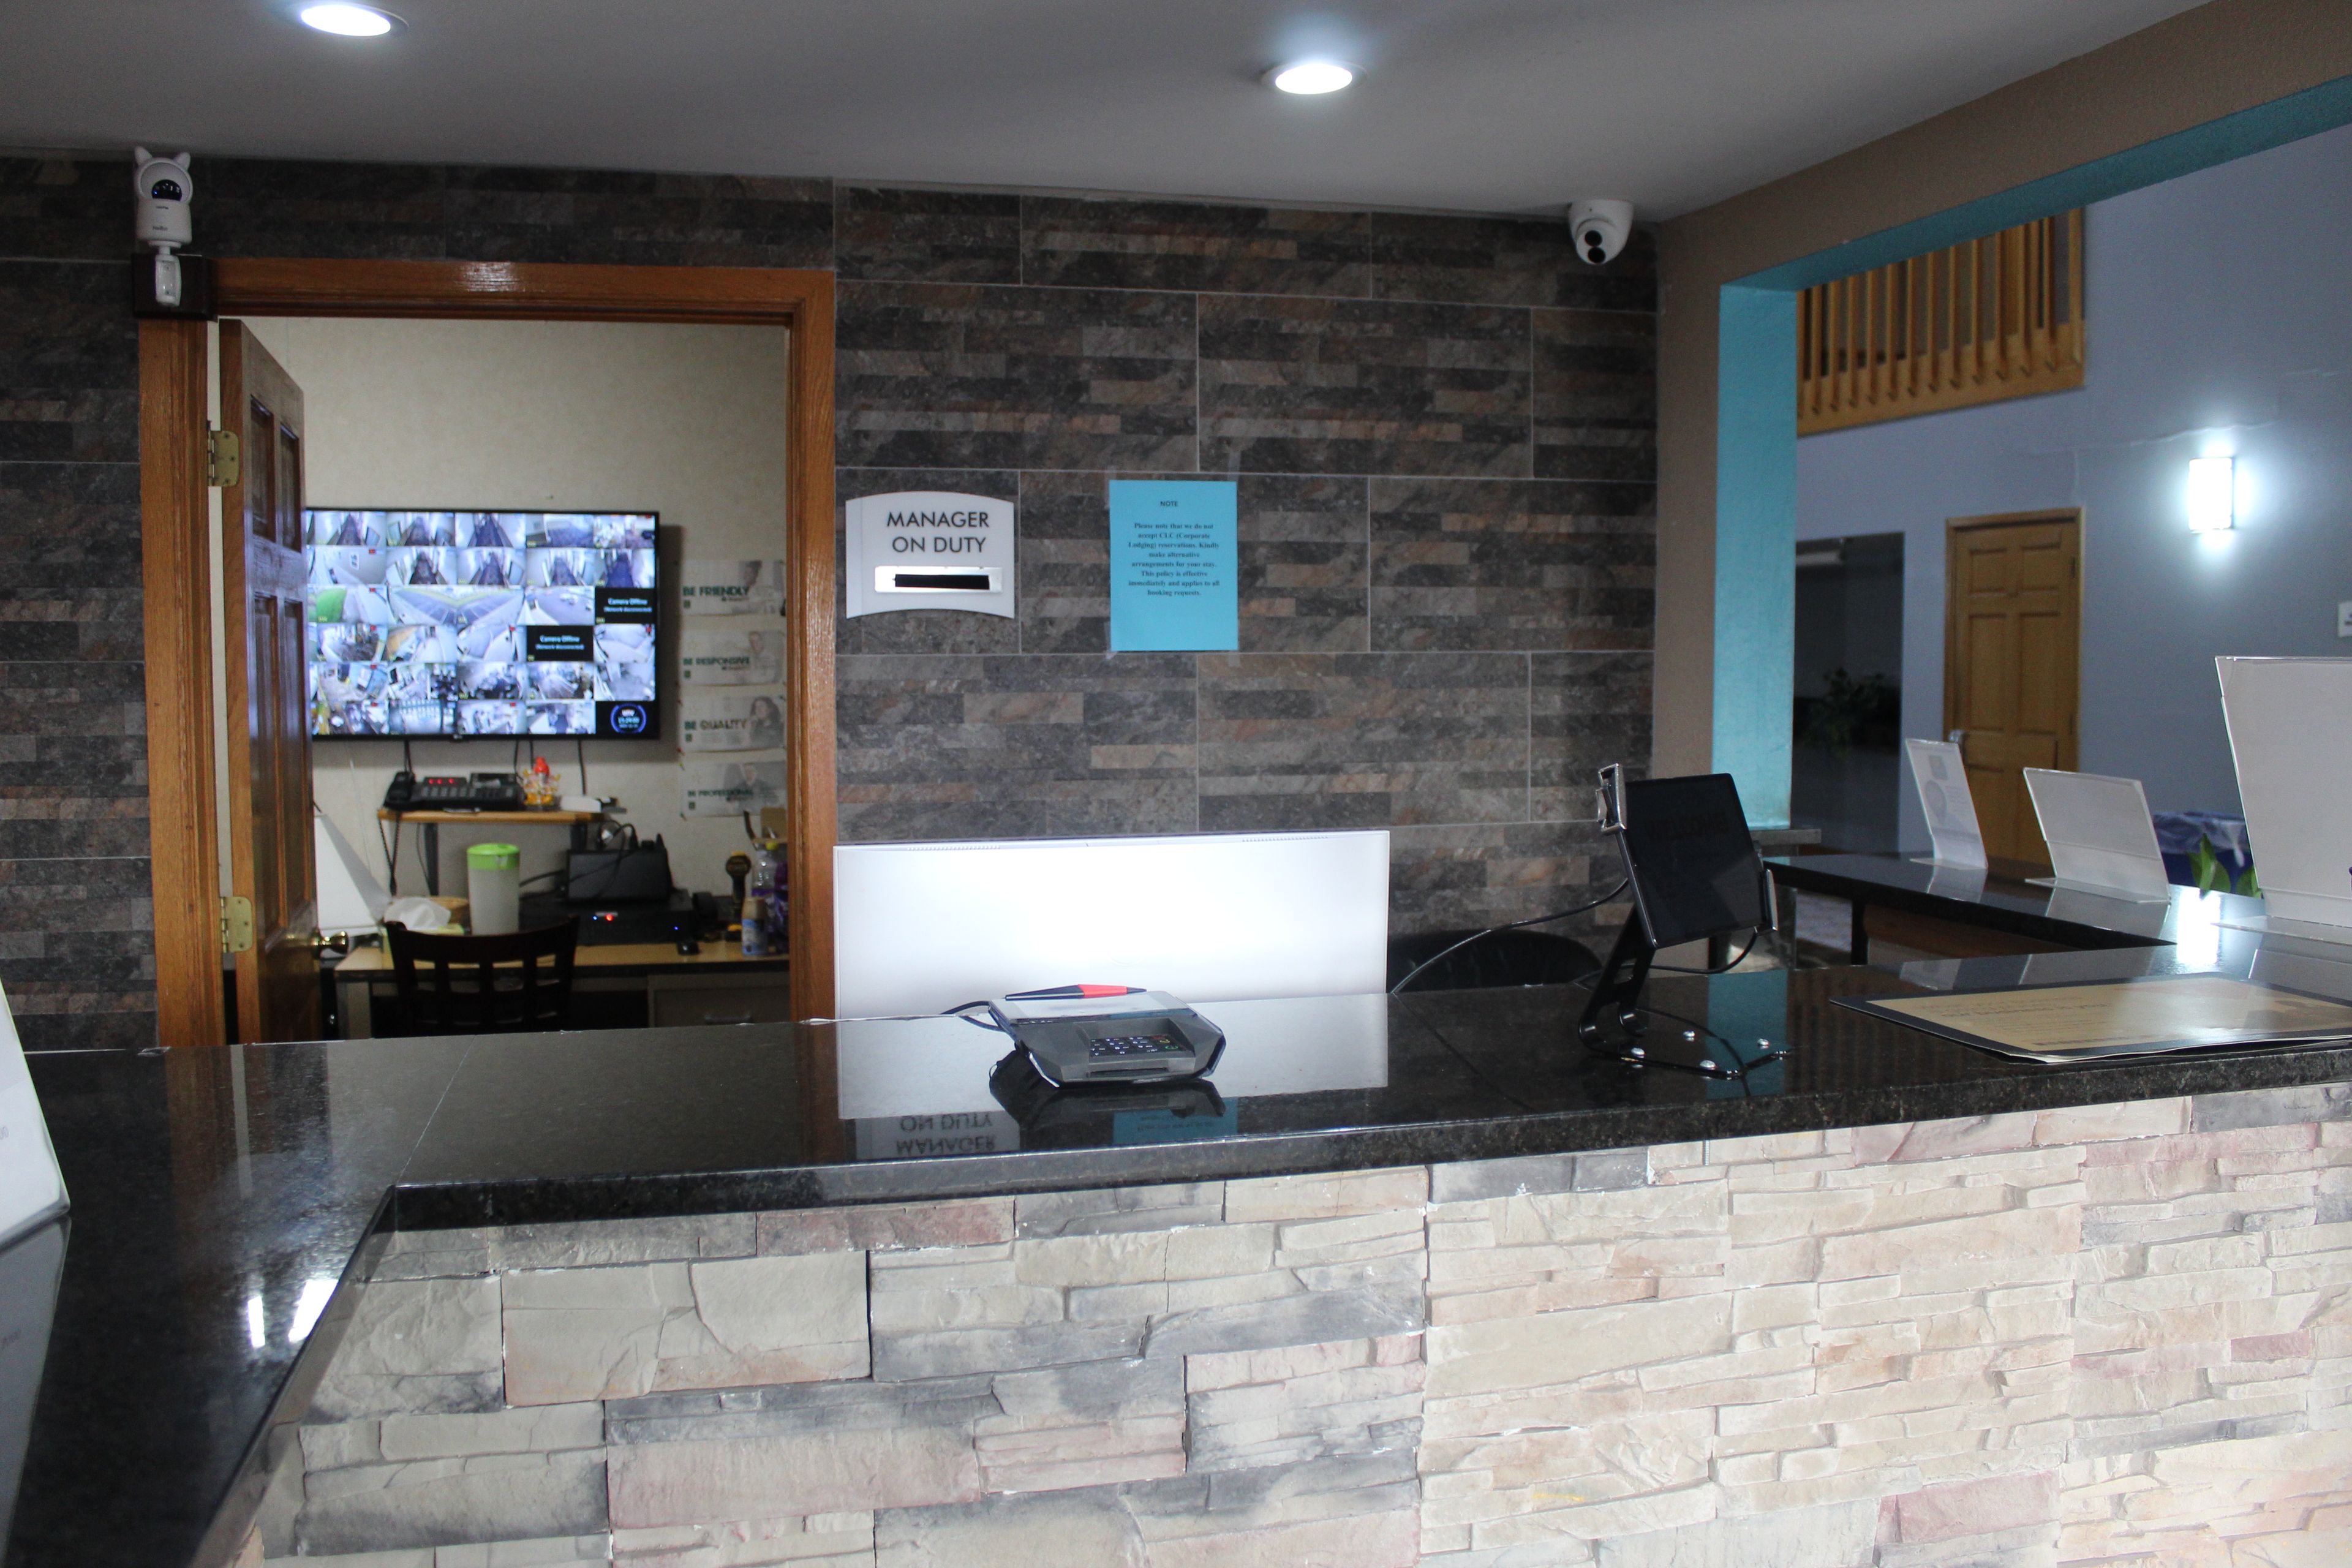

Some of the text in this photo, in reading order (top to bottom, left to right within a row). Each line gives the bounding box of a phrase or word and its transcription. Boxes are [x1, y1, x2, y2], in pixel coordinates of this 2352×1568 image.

[887, 511, 989, 527] MANAGER
[892, 537, 986, 553] ON DUTY
[683, 586, 750, 596] BE FRIENDLY
[684, 719, 748, 729] BE QUALITY
